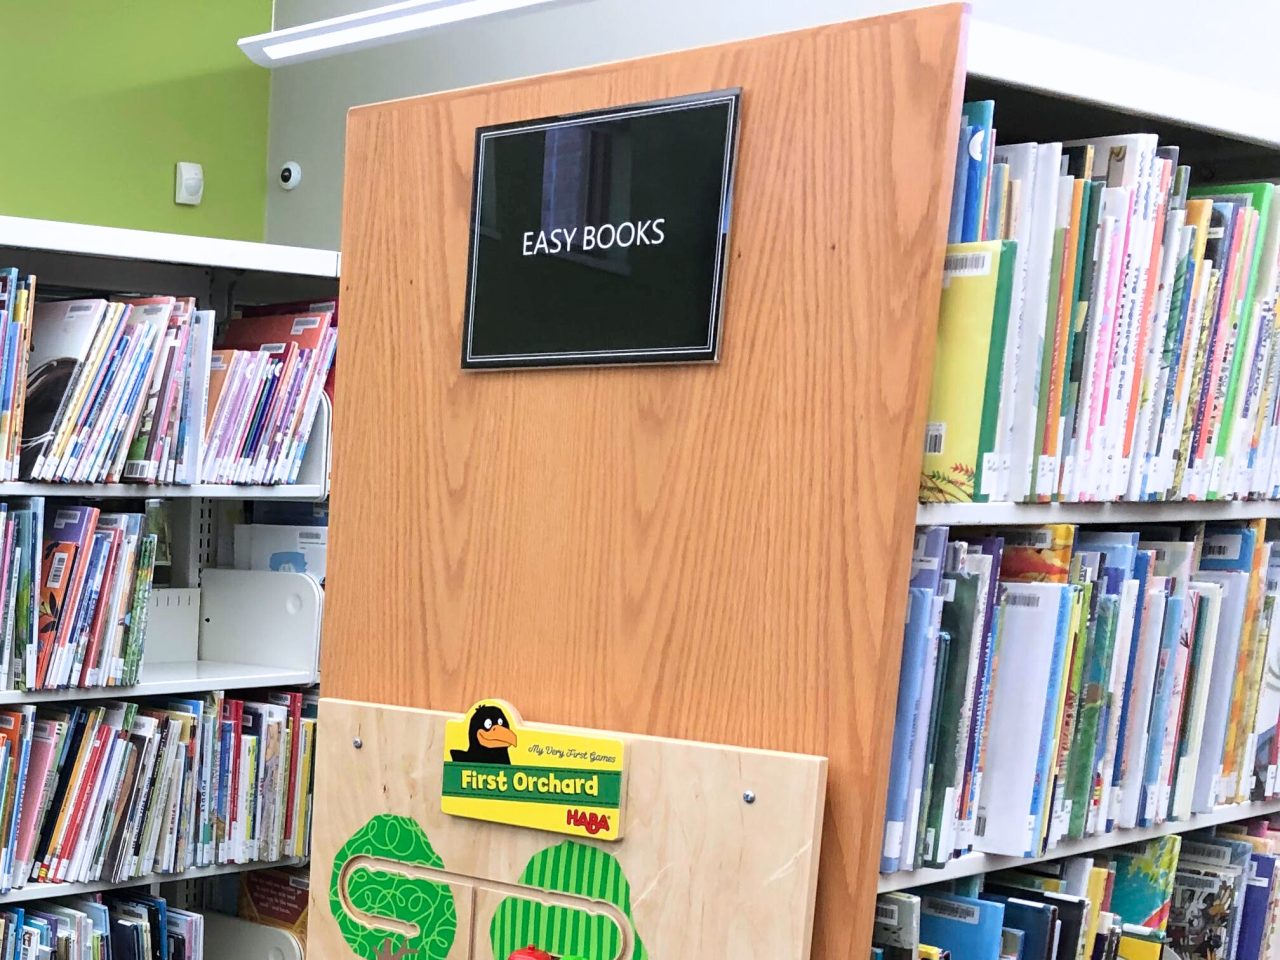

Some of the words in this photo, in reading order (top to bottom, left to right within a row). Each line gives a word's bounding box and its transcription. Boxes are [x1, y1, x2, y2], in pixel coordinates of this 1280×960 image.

[523, 228, 577, 256] EASY
[583, 218, 666, 251] BOOKS
[528, 744, 544, 756] My
[546, 746, 564, 759] Very
[566, 748, 588, 759] First
[589, 751, 616, 764] Games
[461, 770, 508, 792] First
[513, 771, 599, 797] Orchard
[566, 809, 610, 834] HABA
